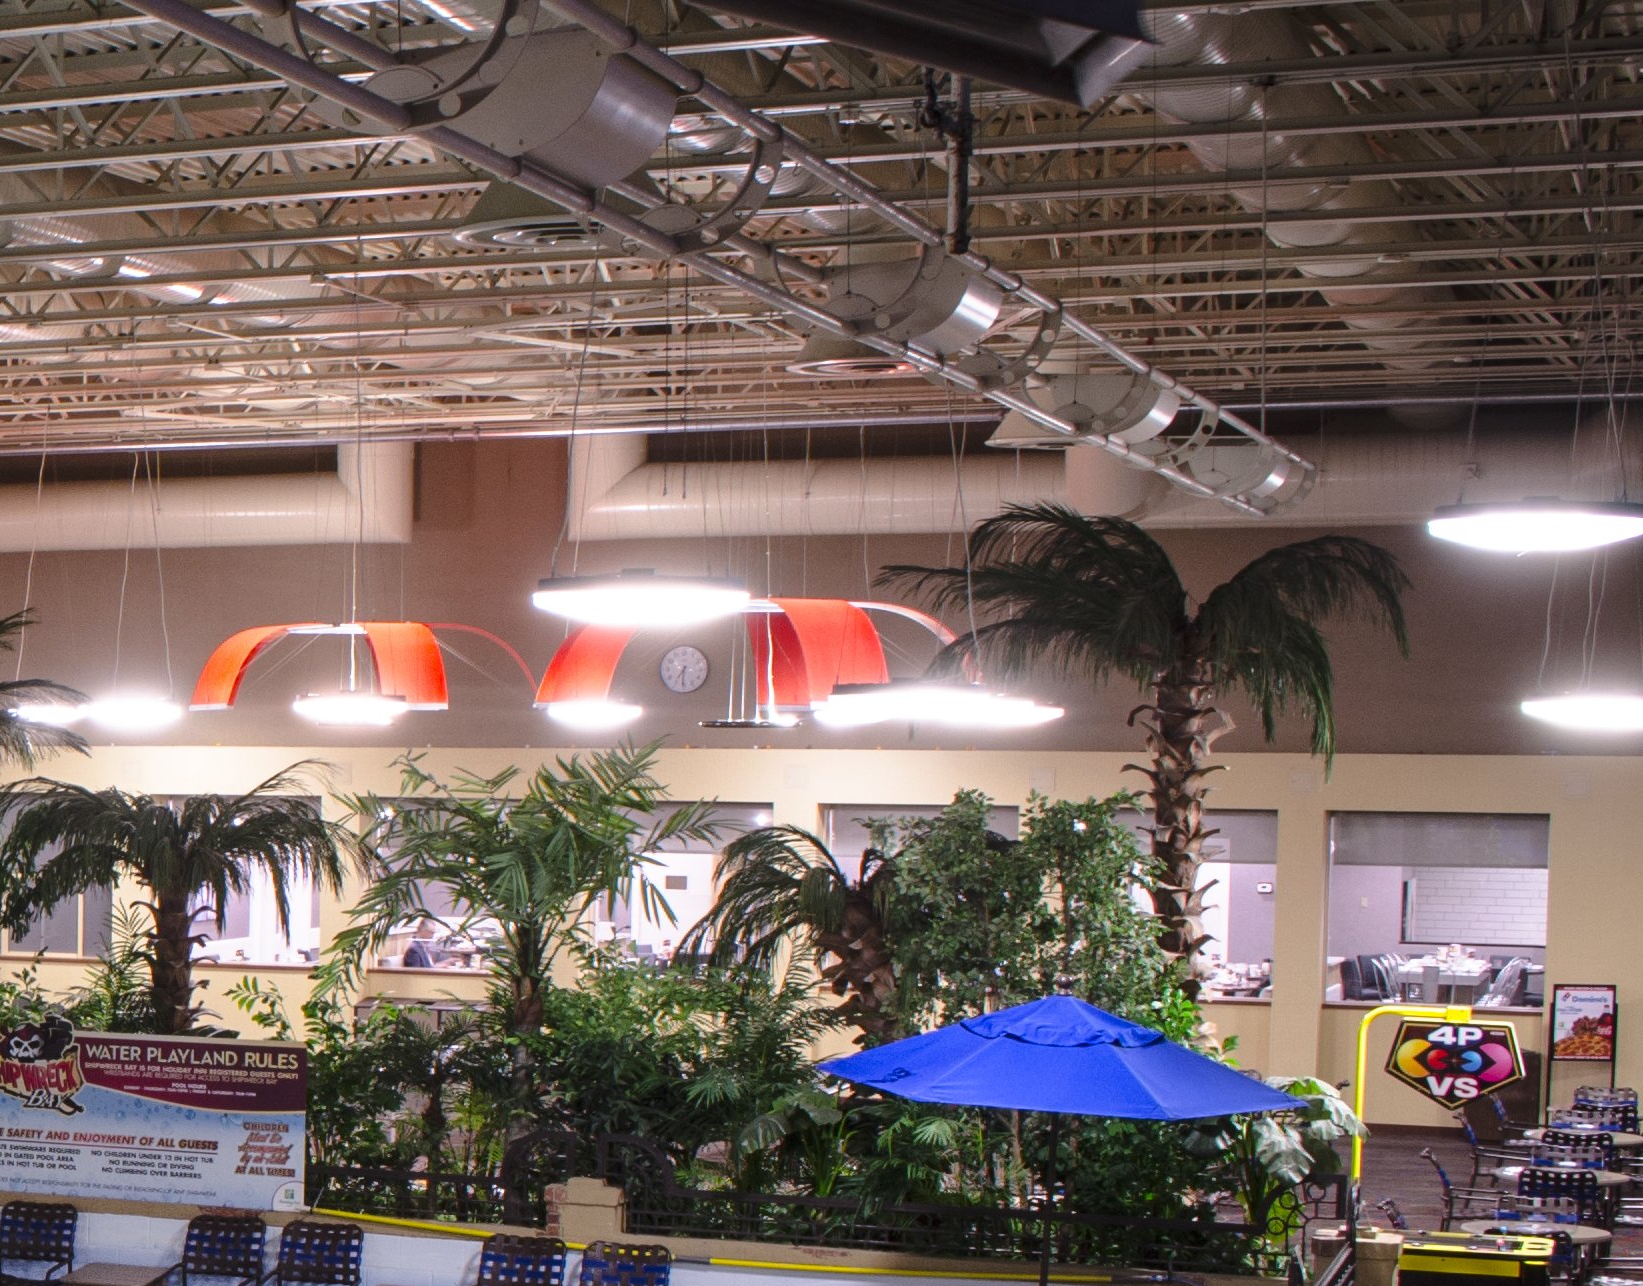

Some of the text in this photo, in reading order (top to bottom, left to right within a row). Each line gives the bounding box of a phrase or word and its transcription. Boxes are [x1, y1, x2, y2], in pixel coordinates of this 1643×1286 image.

[1427, 1025, 1483, 1046] 4P
[86, 1044, 299, 1070] WATER PLAYLAND RULES
[1426, 1075, 1479, 1099] VS
[6, 1128, 43, 1139] SAFETY
[46, 1130, 70, 1141] AND
[73, 1131, 137, 1146] ENJOYMENT
[139, 1136, 154, 1146] OF
[157, 1137, 175, 1148] ALL
[178, 1139, 219, 1150] GUESTS
[138, 1152, 162, 1160] UNDER
[58, 1163, 77, 1171] POOL
[248, 1166, 265, 1175] ALL
[170, 1171, 202, 1179] BARRIERS
